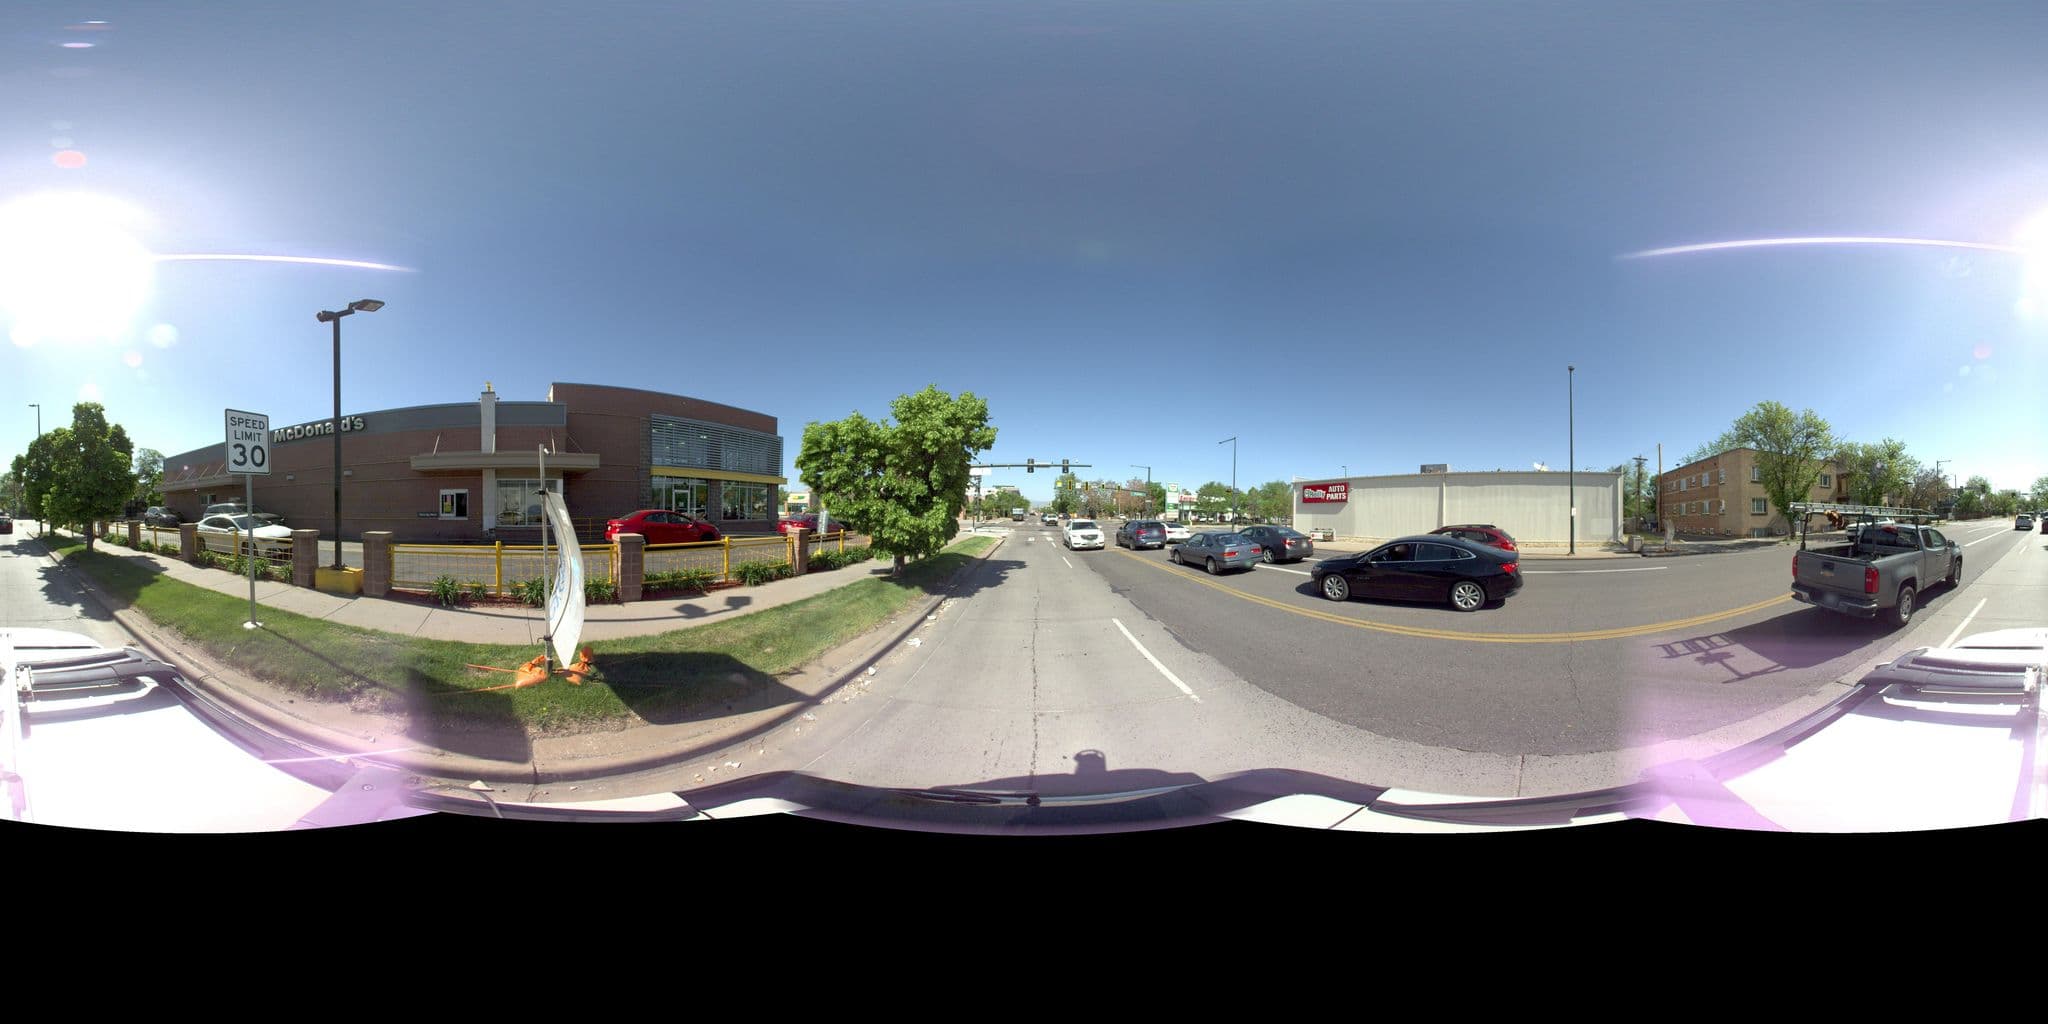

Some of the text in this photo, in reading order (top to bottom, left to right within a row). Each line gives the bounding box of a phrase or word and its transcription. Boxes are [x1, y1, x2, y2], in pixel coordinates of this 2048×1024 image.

[230, 416, 265, 430] SPEED
[273, 416, 365, 443] McDonad's
[234, 430, 262, 442] LIMIT
[232, 443, 266, 468] 30
[1328, 485, 1345, 493] AUTO
[1326, 492, 1347, 500] PARTS
